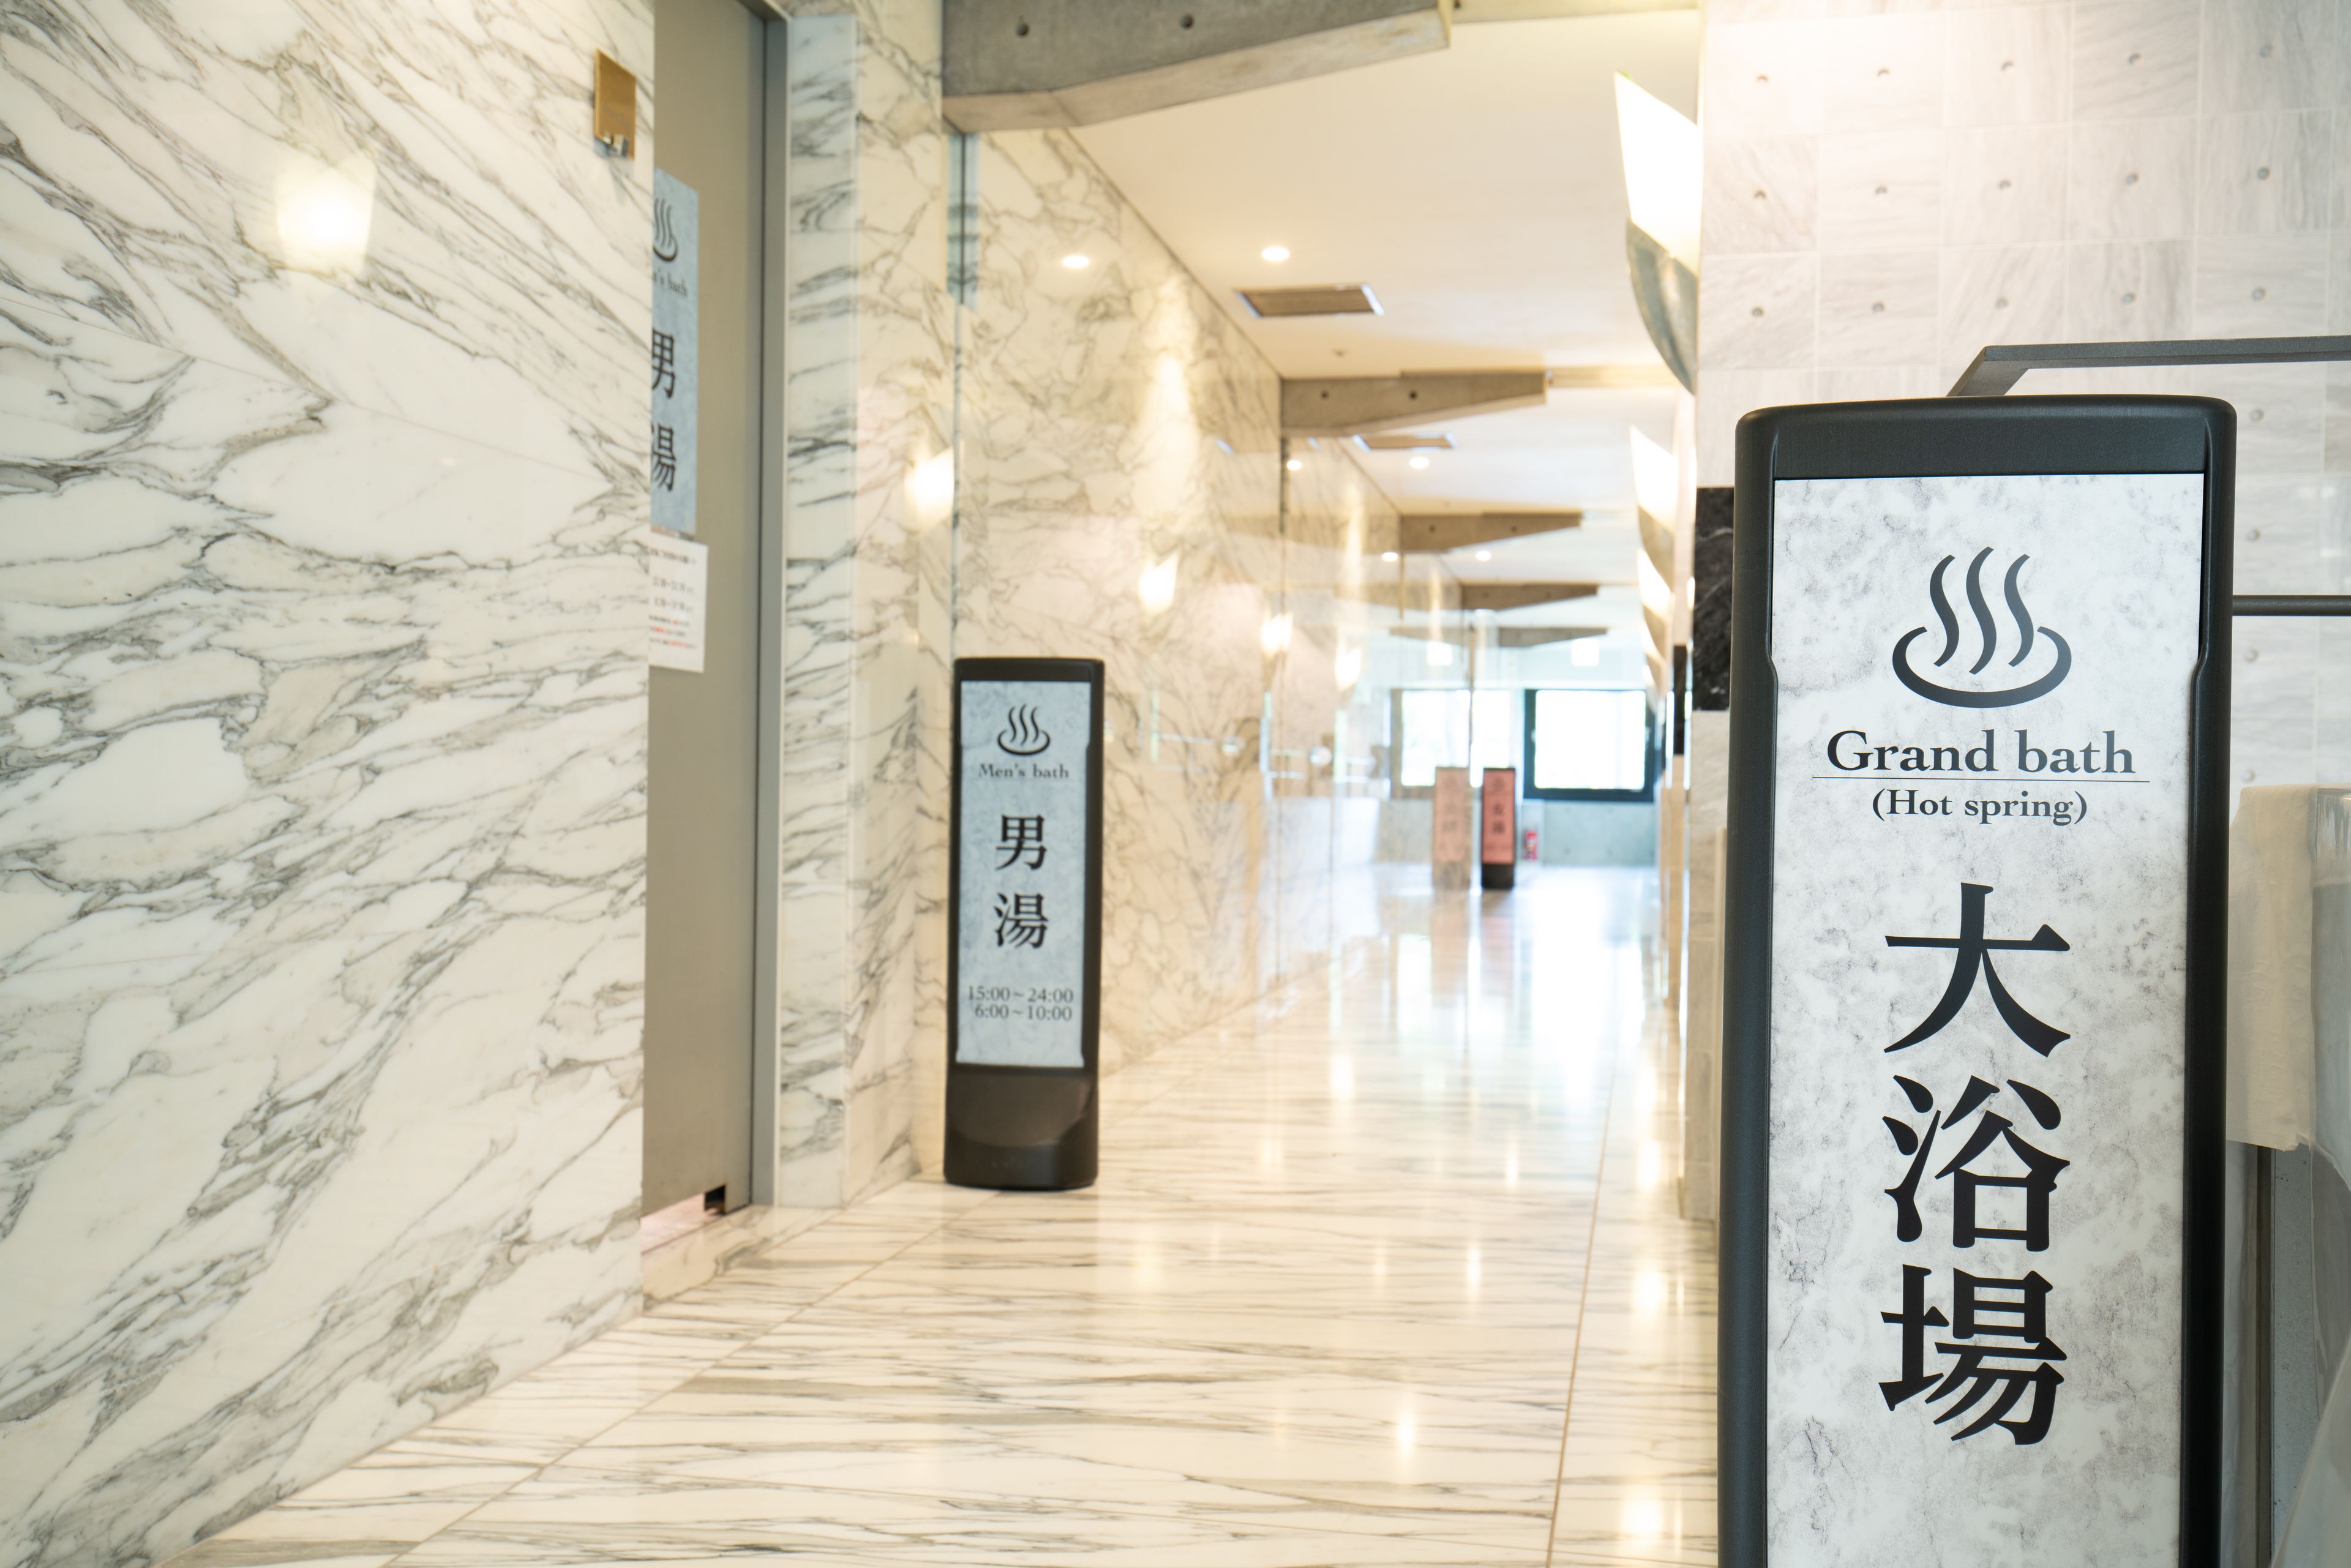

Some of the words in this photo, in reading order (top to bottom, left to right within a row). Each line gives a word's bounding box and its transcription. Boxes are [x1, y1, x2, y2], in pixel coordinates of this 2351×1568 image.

[651, 326, 677, 493] 男湯
[978, 763, 1026, 778] Men's
[1033, 763, 1069, 778] bath
[1827, 729, 1999, 772] Grand
[2015, 729, 2135, 773] bath
[1872, 788, 1953, 822] (Hot
[1965, 790, 2087, 826] spring)
[994, 815, 1049, 949] 男湯
[1878, 882, 2071, 1446] 大浴場
